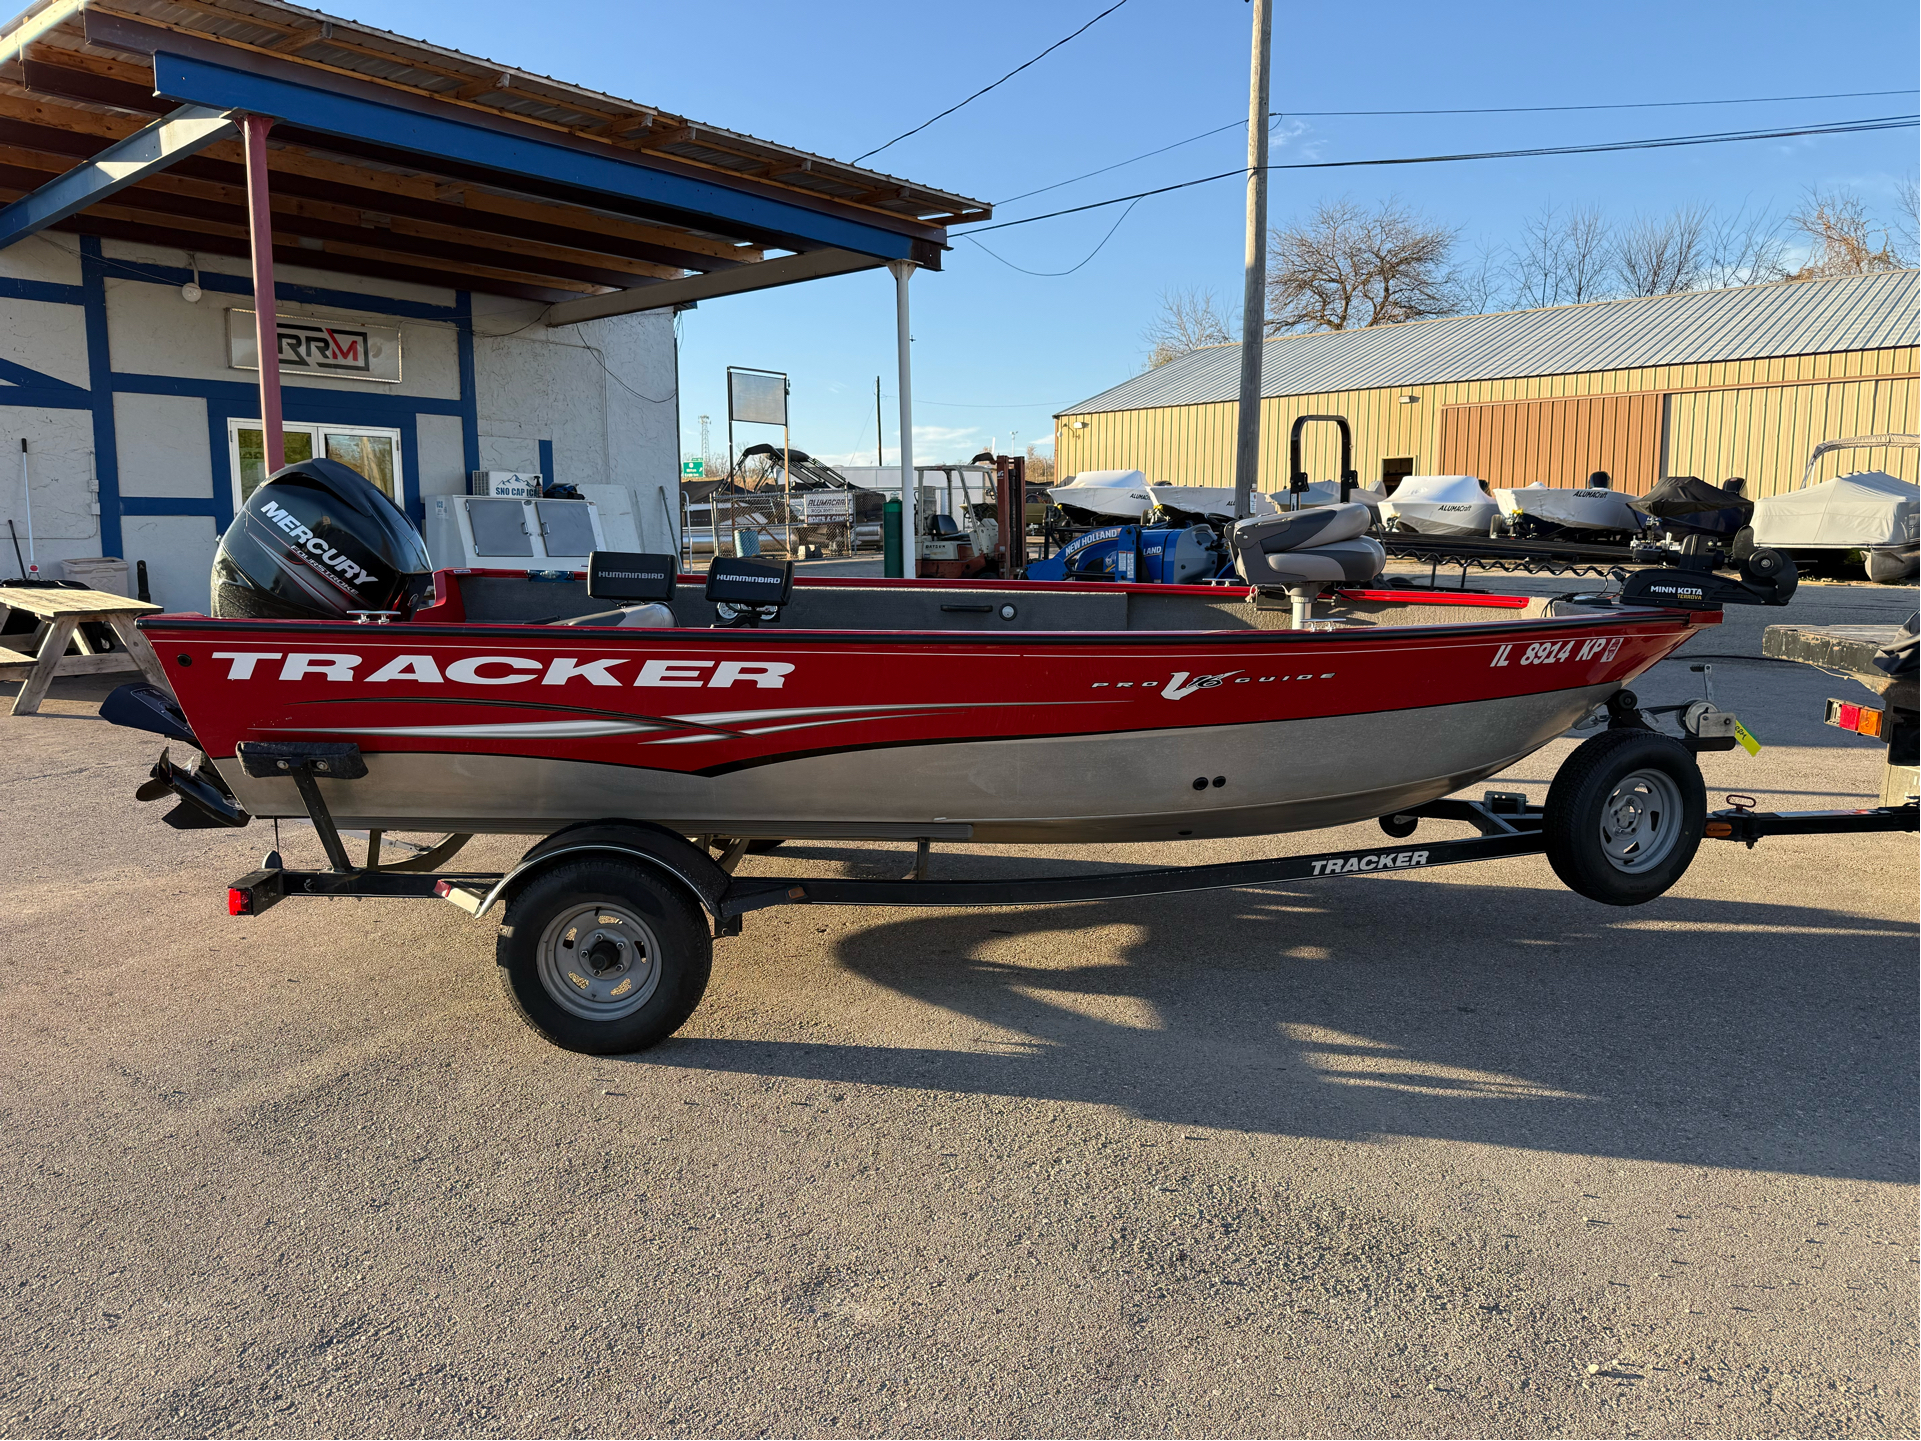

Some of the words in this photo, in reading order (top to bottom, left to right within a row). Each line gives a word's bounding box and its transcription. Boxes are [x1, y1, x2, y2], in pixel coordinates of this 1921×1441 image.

[495, 486, 510, 496] SNO
[511, 487, 525, 497] CAP
[807, 499, 853, 507] ALUMACRAT
[260, 500, 379, 585] MERCURY
[1065, 540, 1081, 557] NEW
[1081, 528, 1118, 546] HOLLAND
[1143, 545, 1162, 556] LAND
[290, 545, 359, 596] FOURSTROKE
[598, 570, 665, 580] HUMMINBIRD
[716, 573, 781, 584] HUMMINBIRD
[1650, 585, 1677, 594] MINN
[1677, 586, 1703, 596] KOTA
[1489, 644, 1513, 668] IL
[1519, 640, 1576, 666] 8914
[1575, 638, 1607, 662] KP
[211, 651, 796, 689] TRACKER
[1091, 681, 1159, 689] PRO
[1234, 672, 1336, 684] GUIDE
[1310, 850, 1430, 876] TRACKER
